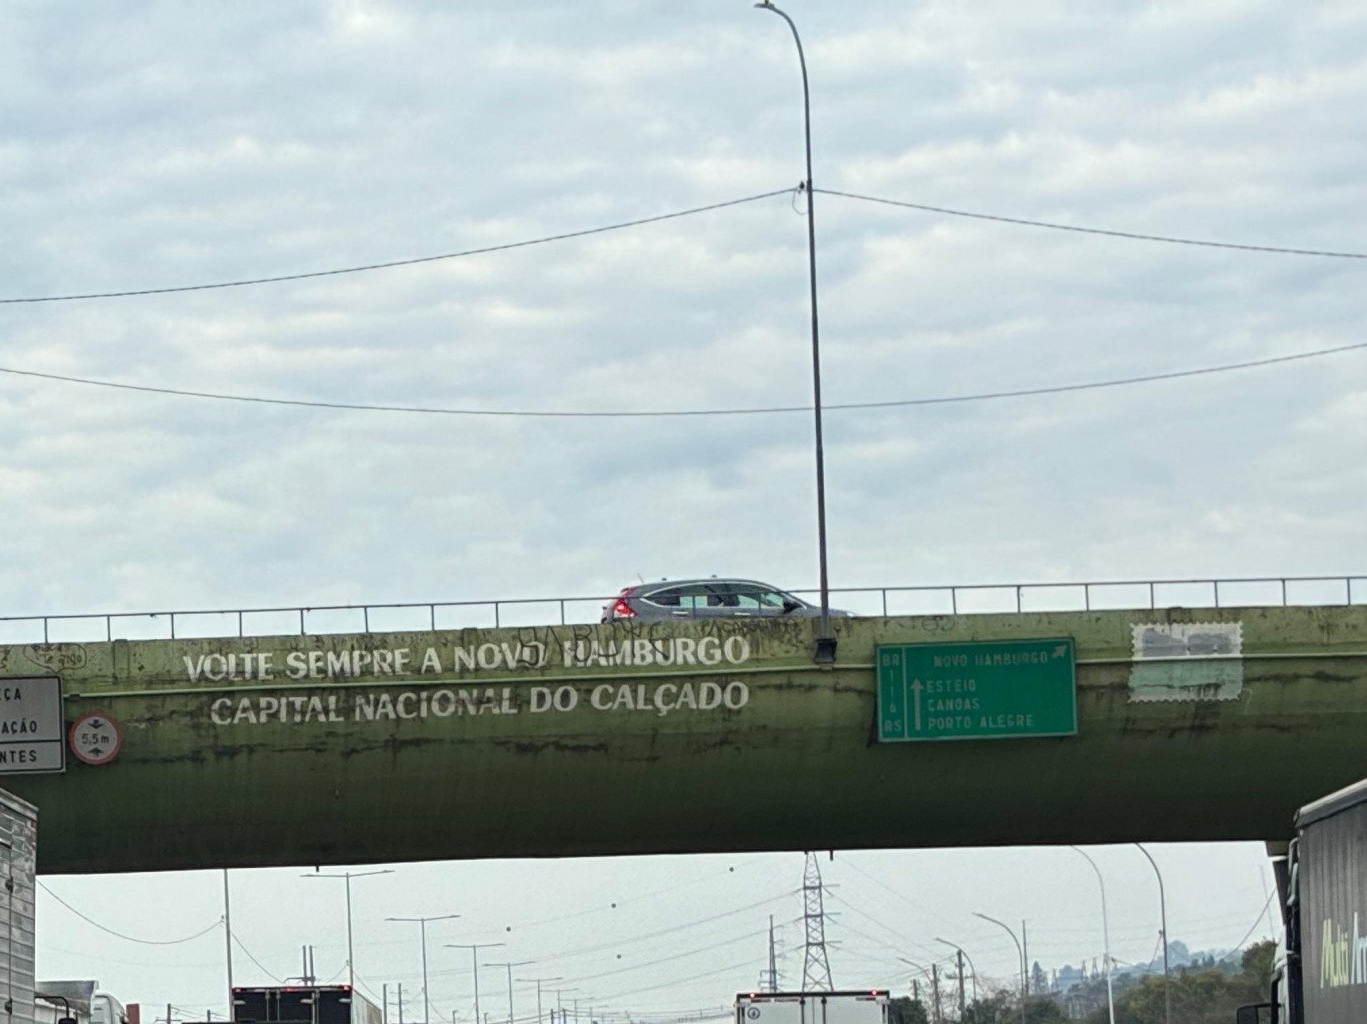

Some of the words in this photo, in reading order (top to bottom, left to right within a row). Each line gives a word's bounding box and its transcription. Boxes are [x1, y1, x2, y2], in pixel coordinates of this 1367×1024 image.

[183, 652, 274, 682] VOLTE
[286, 649, 411, 680] SEMPRE
[421, 647, 442, 674] A
[454, 641, 546, 670] NOVO
[563, 636, 751, 667] HAMBURGO
[882, 654, 900, 667] BR
[926, 679, 976, 693] ESTEIO
[211, 696, 344, 725] CAPITAL
[355, 689, 519, 722] NACIONAL
[530, 686, 579, 713] DO
[590, 681, 749, 717] CALÇADO
[927, 698, 980, 711] CANOAS
[928, 716, 971, 730] PORTO
[980, 714, 1033, 728] ALEGRE
